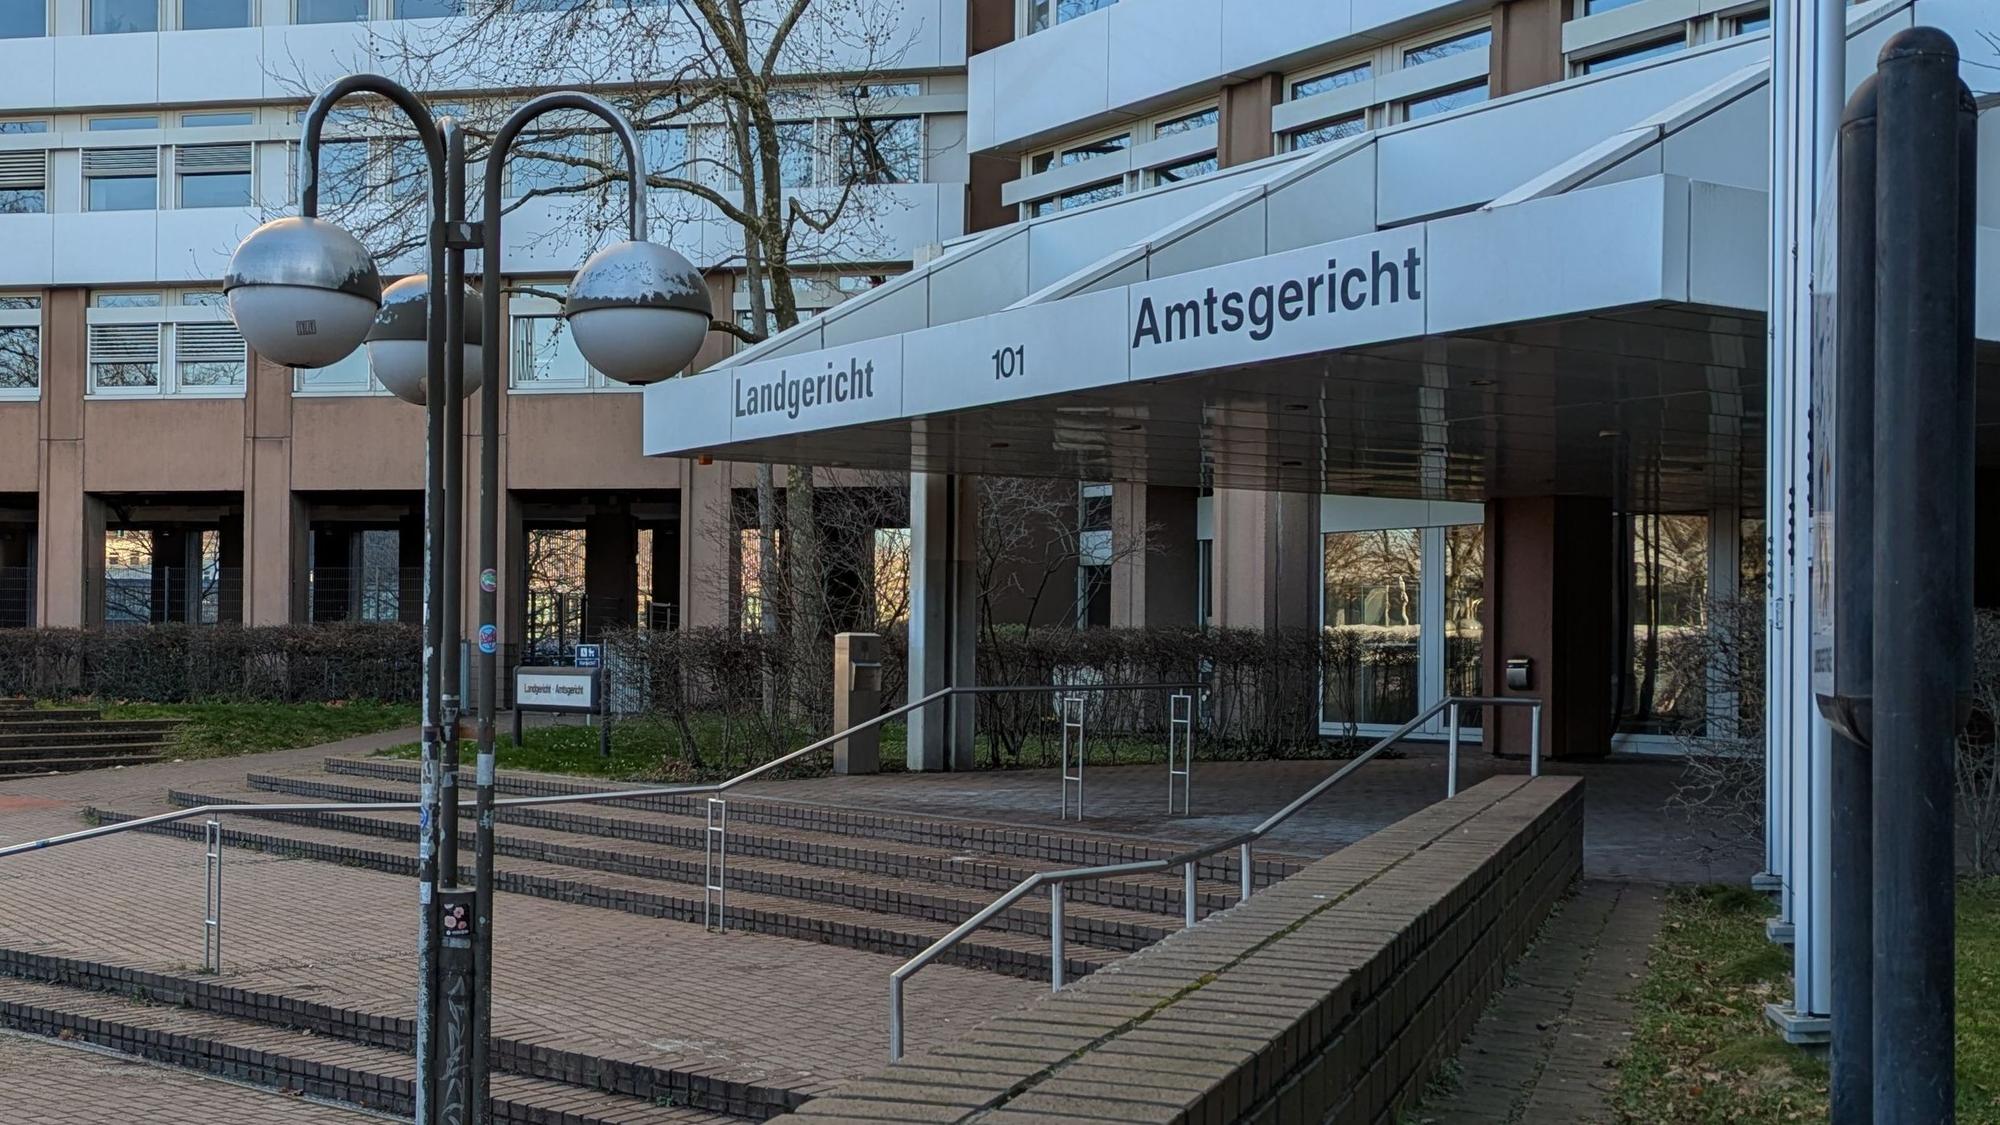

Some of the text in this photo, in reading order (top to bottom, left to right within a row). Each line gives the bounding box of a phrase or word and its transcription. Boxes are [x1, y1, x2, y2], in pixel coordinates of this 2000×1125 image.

[1131, 246, 1422, 350] Amtsgericht
[991, 344, 1025, 381] 101
[735, 358, 874, 420] Landgericht
[524, 684, 583, 696] Landgericht Amtsgericht
